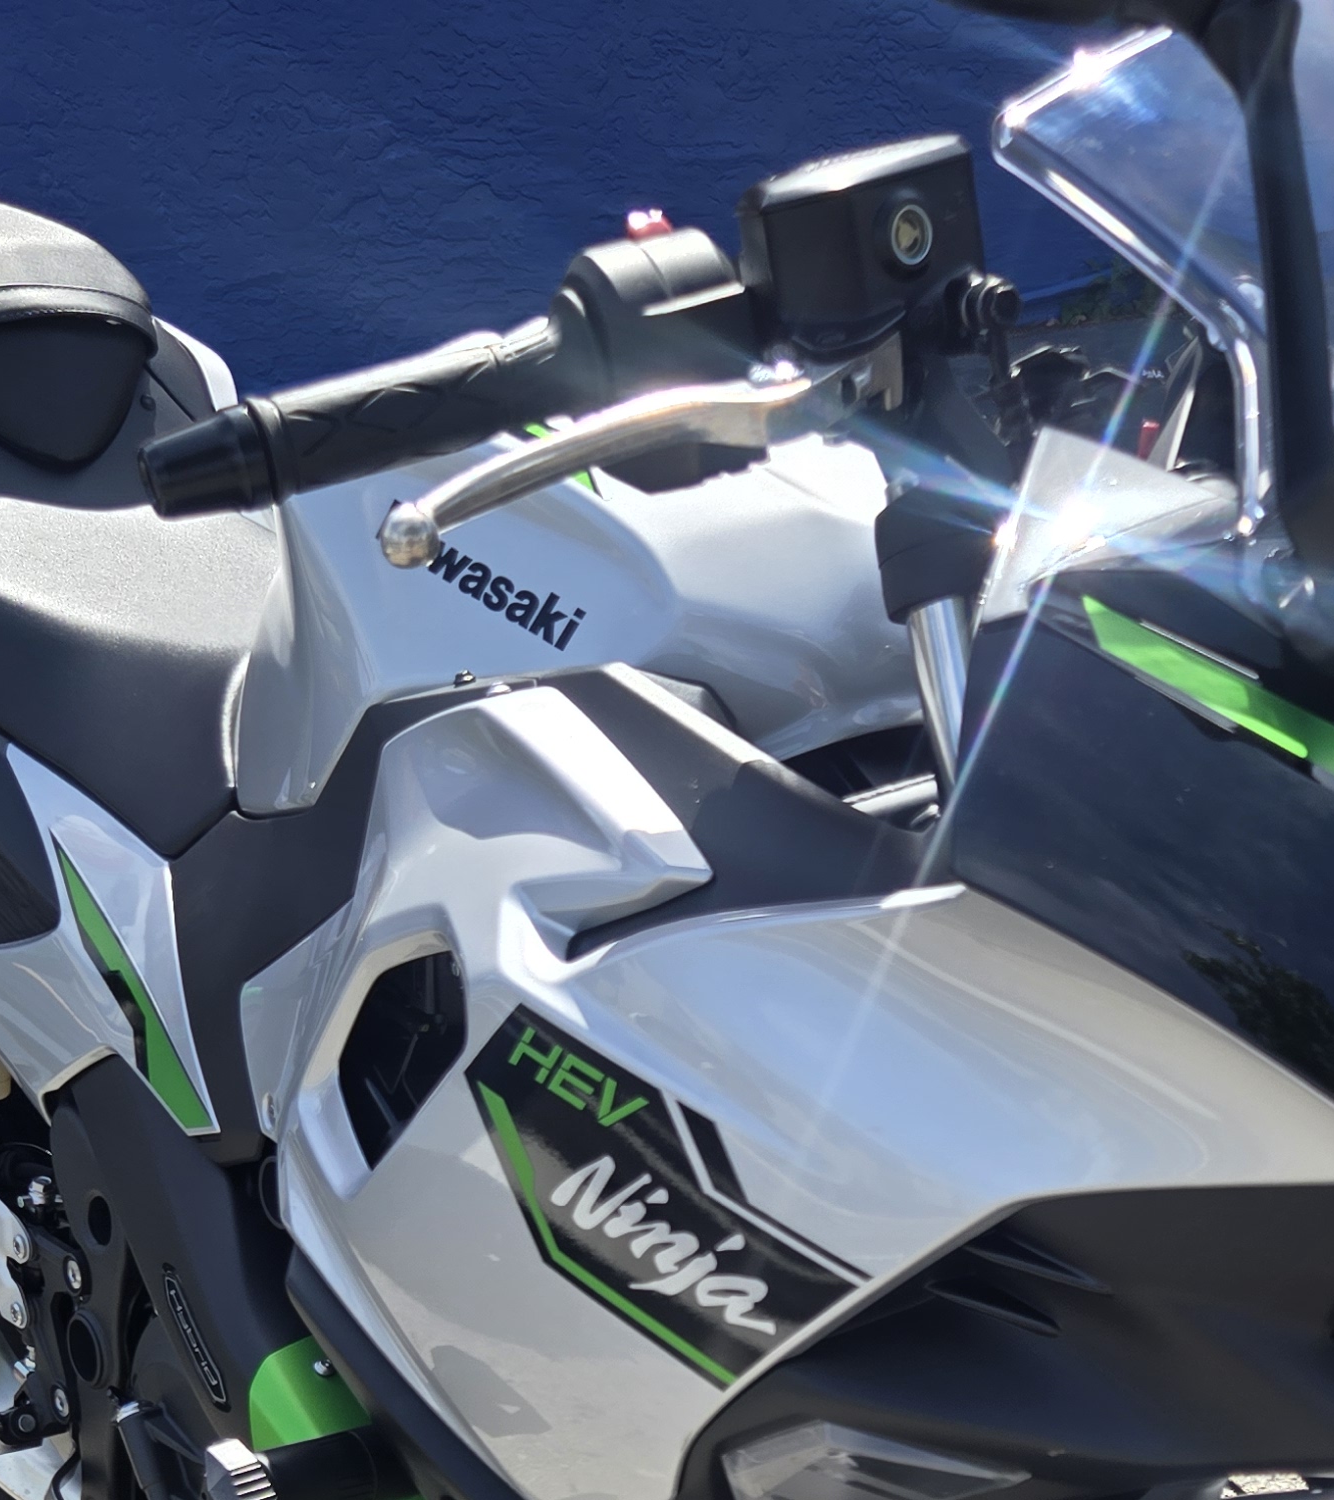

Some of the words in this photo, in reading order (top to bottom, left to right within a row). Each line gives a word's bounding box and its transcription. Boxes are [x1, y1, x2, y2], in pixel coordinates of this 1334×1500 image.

[375, 498, 586, 651] wasaki
[508, 1027, 649, 1127] HEV
[551, 1155, 777, 1335] Ninja
